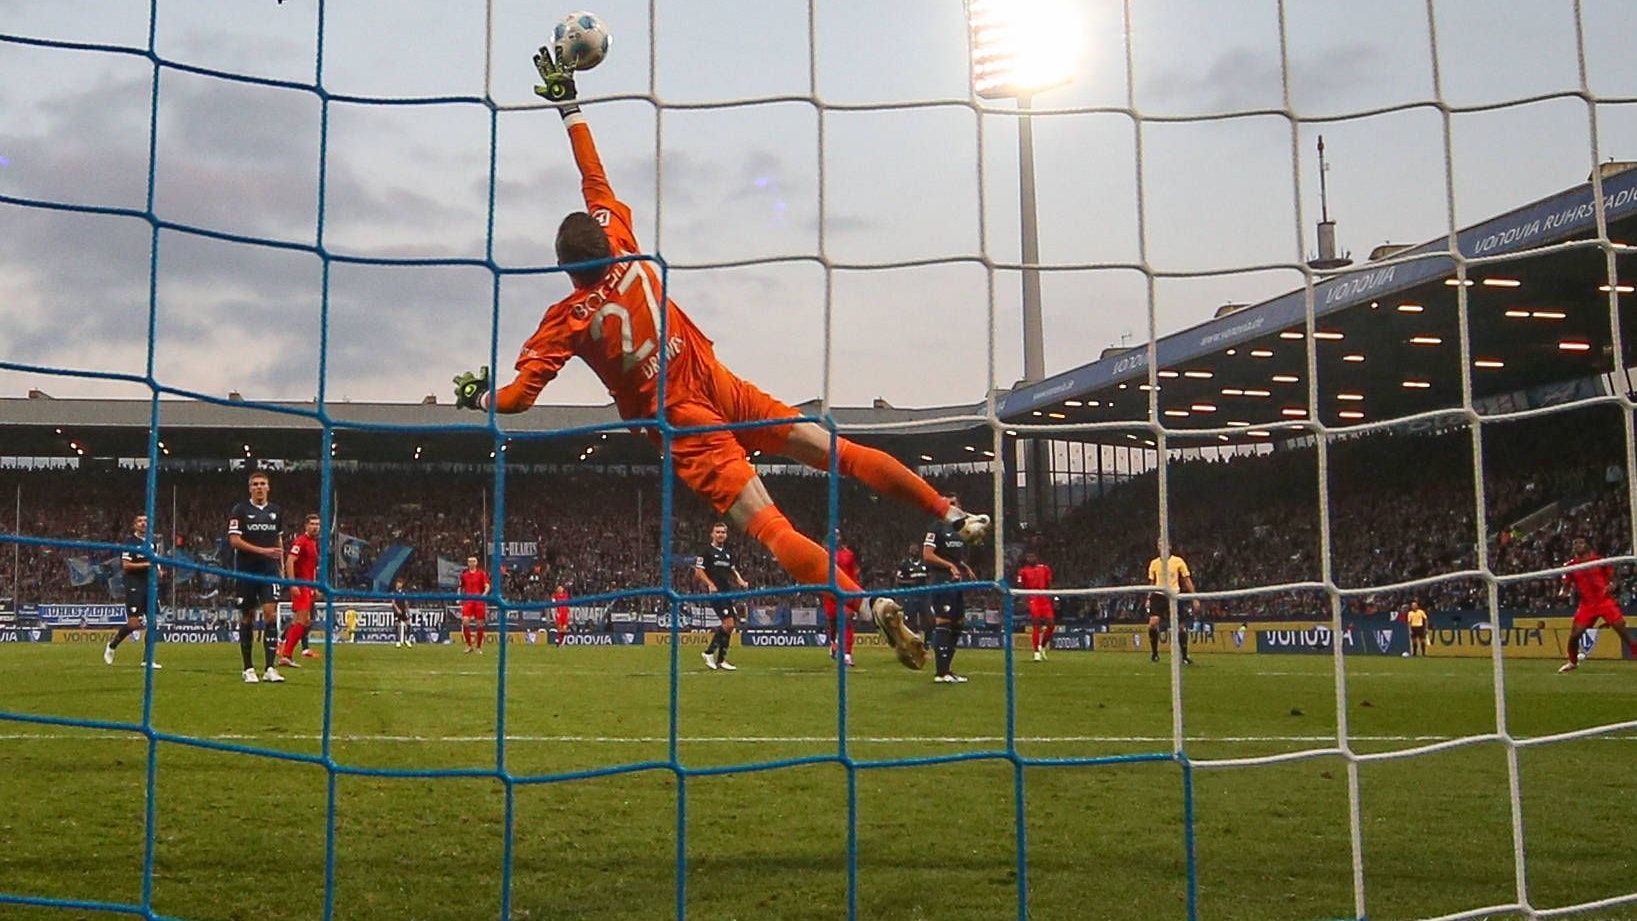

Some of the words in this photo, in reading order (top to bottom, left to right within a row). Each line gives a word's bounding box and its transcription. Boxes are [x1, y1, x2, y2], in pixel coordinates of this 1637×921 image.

[1474, 219, 1540, 254] VONOVIA
[1543, 186, 1637, 231] RUHRSADI
[1326, 266, 1395, 304] VONOVIA
[163, 632, 218, 643] VONOVIA
[656, 635, 709, 645] VOOVIA
[752, 635, 805, 646] VONOVIA
[1267, 630, 1354, 647] VONOVA
